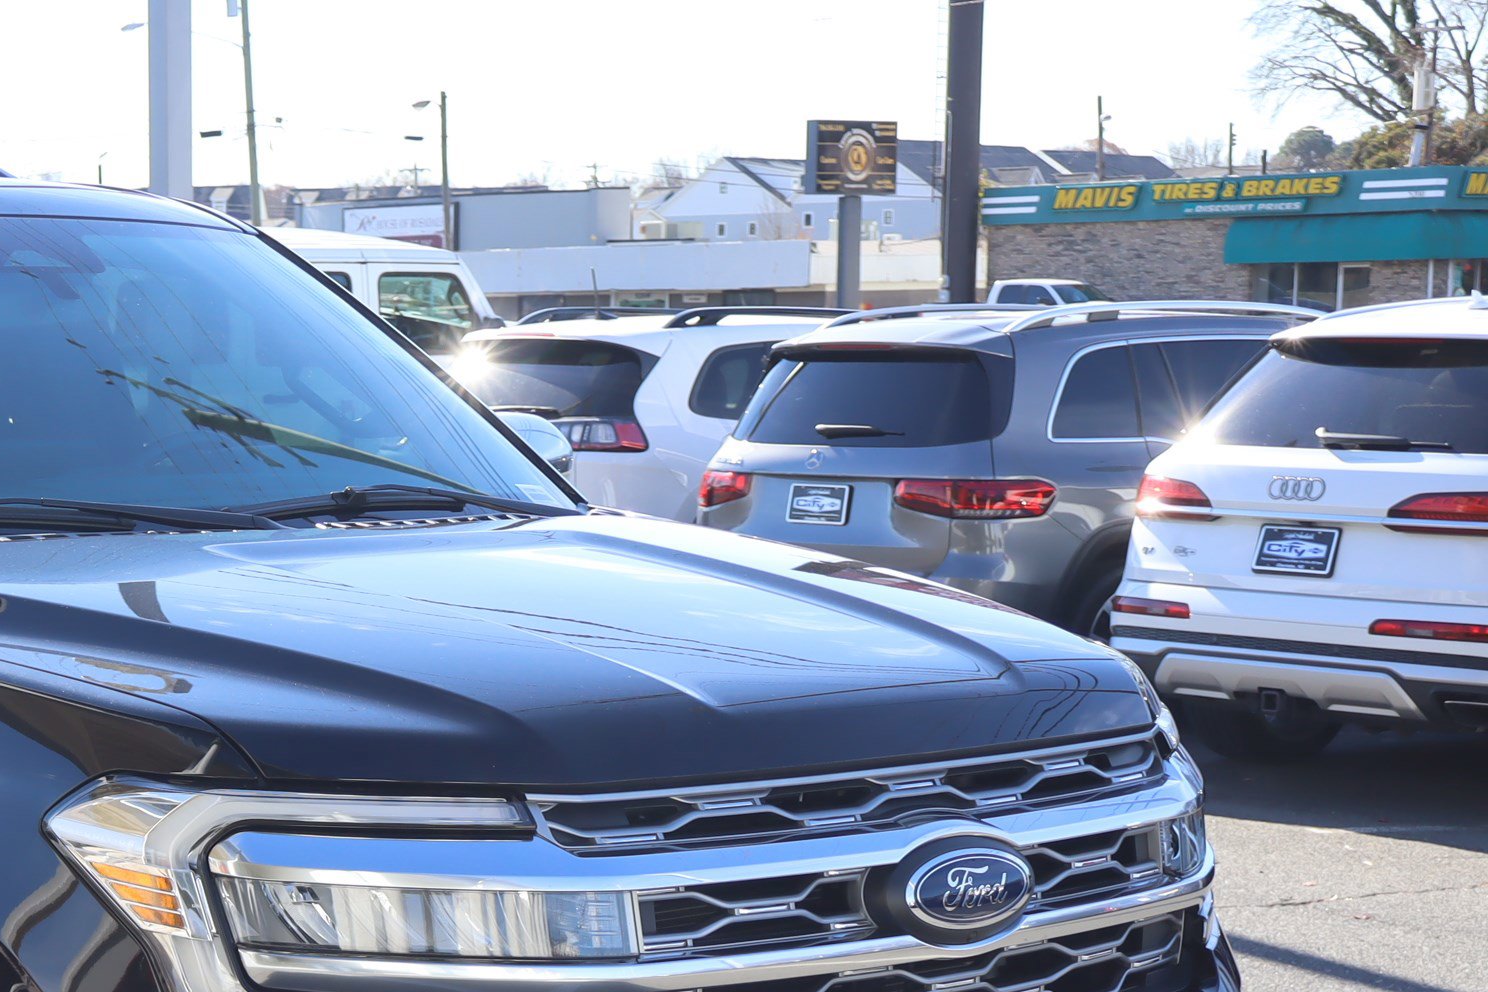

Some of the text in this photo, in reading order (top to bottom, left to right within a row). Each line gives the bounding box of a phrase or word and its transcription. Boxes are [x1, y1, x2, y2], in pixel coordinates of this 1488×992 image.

[1053, 176, 1341, 209] MAVIS TIRES & BRAKES
[1195, 203, 1255, 213] DISCOUNT
[1257, 201, 1302, 211] PRICES
[943, 865, 1008, 912] Ford
